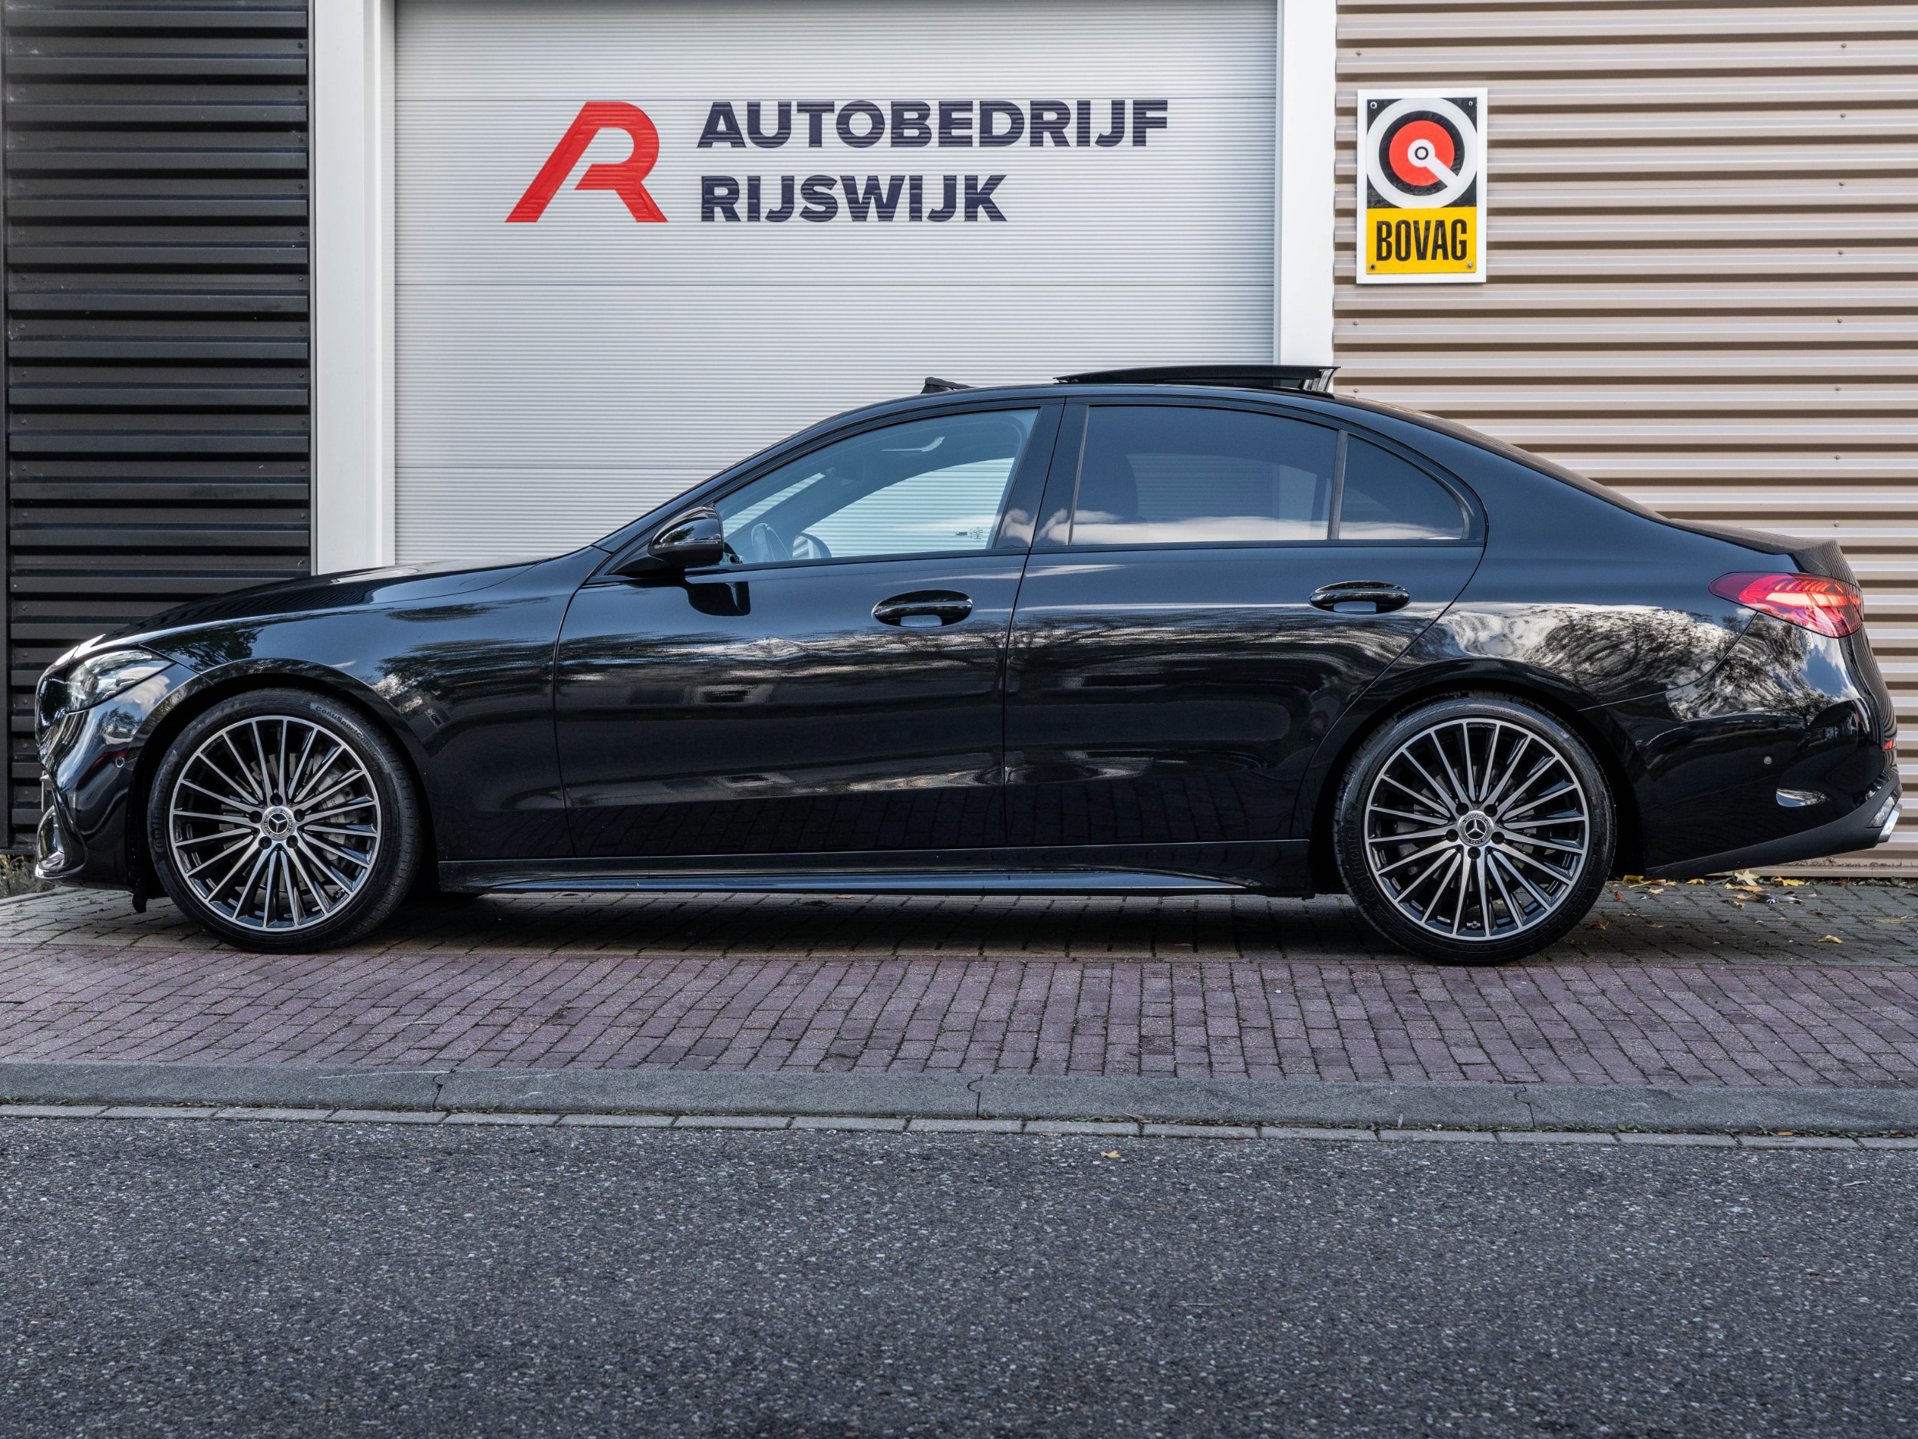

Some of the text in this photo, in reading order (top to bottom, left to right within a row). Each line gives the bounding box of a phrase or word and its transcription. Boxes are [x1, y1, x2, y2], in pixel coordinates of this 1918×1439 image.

[697, 100, 1168, 149] AUTOBEDRIJF
[701, 174, 1007, 223] RIJSWIJK
[1376, 219, 1467, 261] BOVAG
